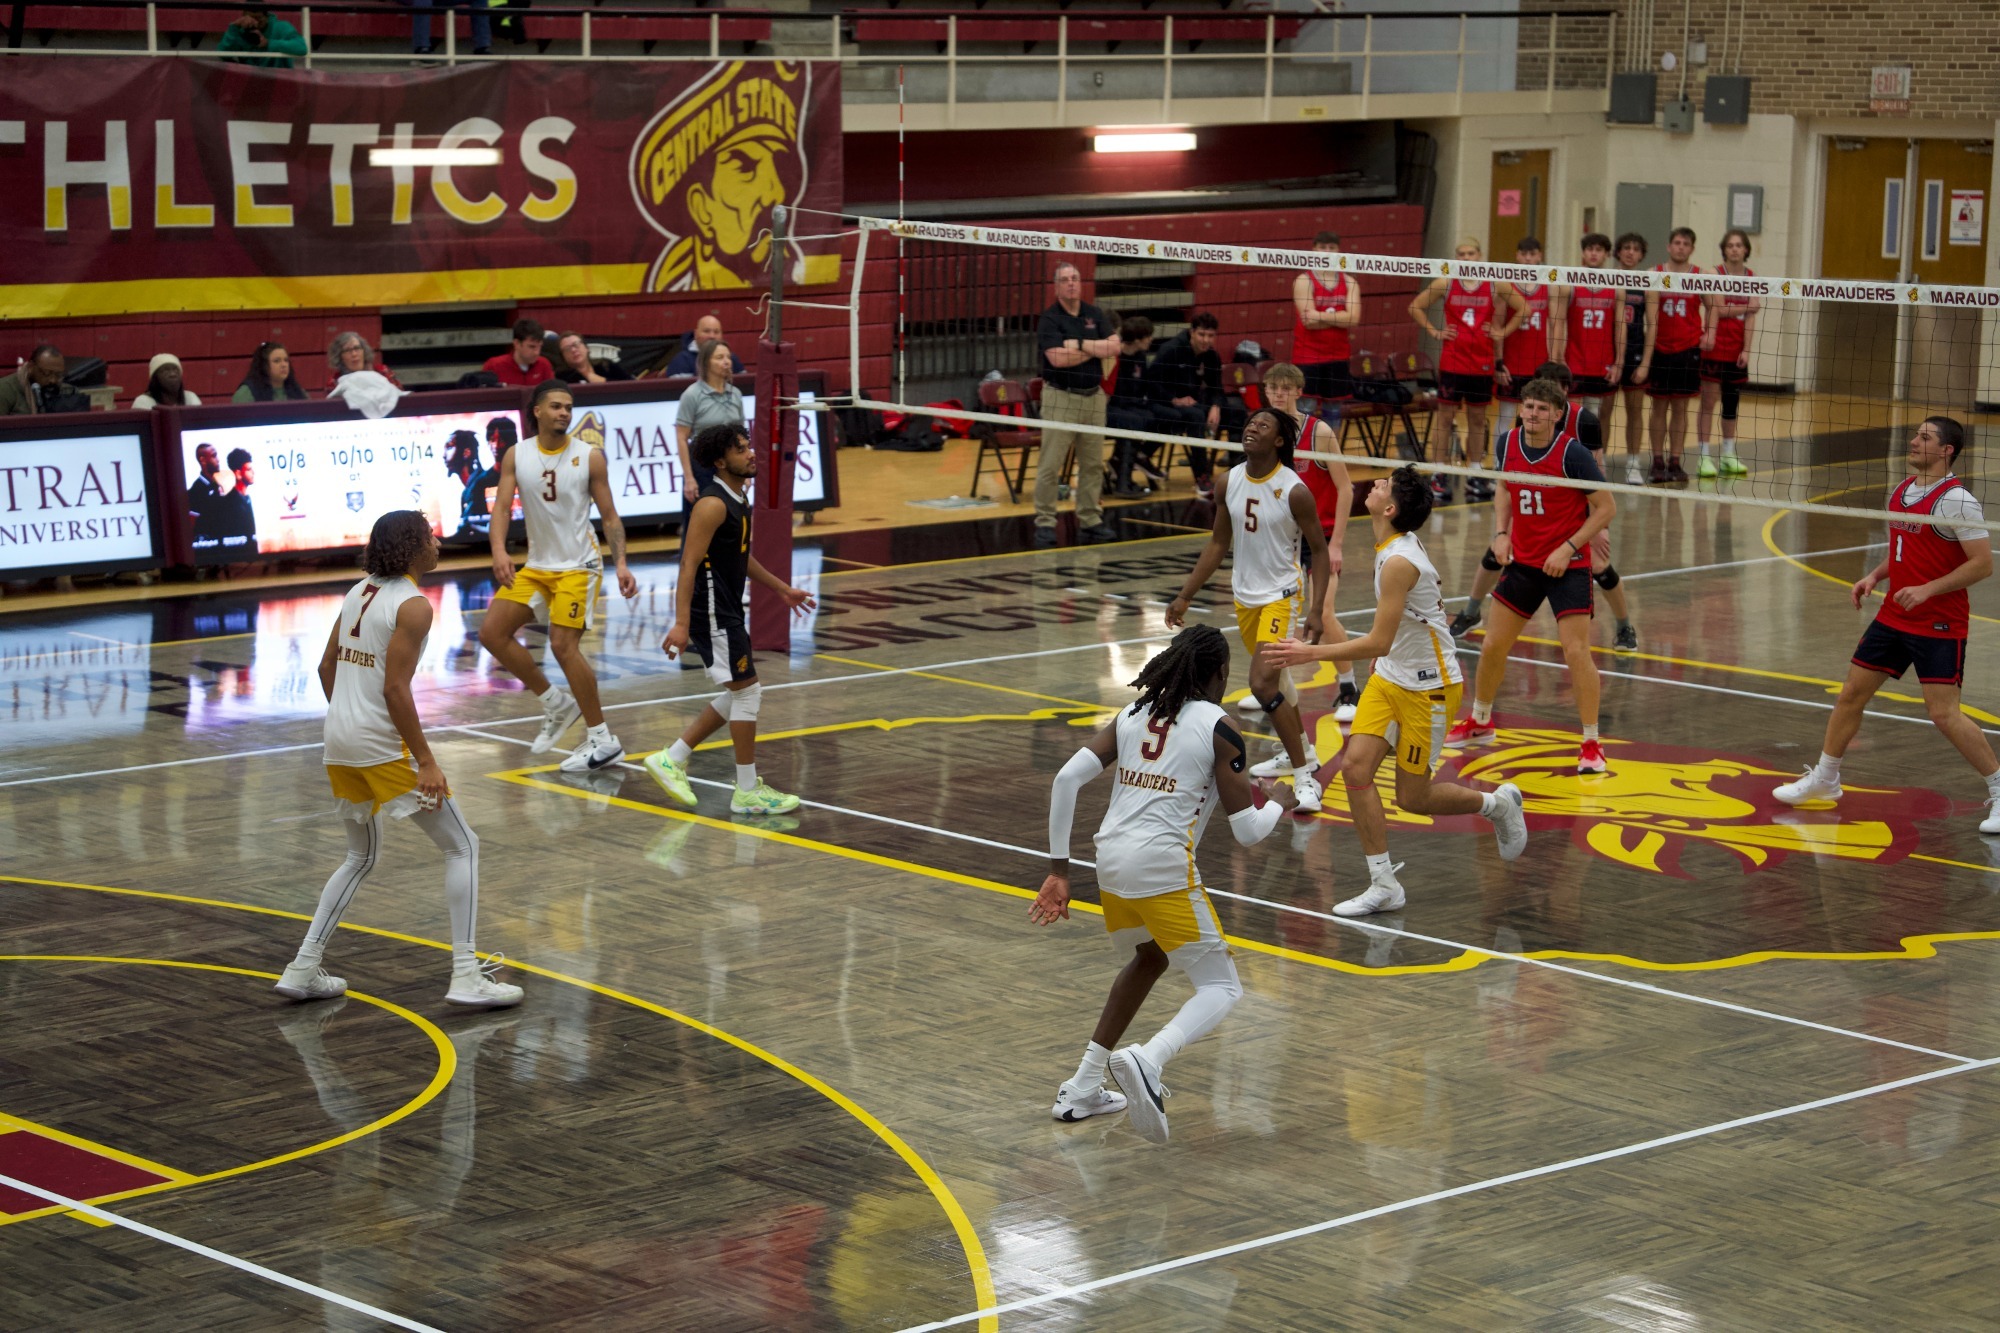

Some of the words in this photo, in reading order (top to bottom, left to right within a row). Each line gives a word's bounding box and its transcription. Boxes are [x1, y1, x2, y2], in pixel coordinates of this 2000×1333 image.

[1877, 73, 1898, 93] EXIT
[651, 91, 735, 206] CENTRAL
[736, 77, 796, 142] STATE
[902, 224, 965, 240] MARAUDERS
[986, 231, 1050, 248] MARAUDERS
[1074, 238, 1139, 255] MARAUDERS
[1163, 245, 1232, 262] MARAUDERS
[1257, 252, 1330, 269] MARAUDERS
[1356, 258, 1431, 275] MARAUDERS
[1458, 265, 1537, 282] MARAUDERS
[1566, 271, 1651, 288] MARAUDERS
[1681, 278, 1769, 295] MARAUDERS
[1801, 284, 1896, 302] MARAUDERS
[1461, 307, 1476, 327] 4
[1582, 308, 1605, 329] 27
[1662, 298, 1687, 318] 44
[269, 449, 306, 473] 10/8
[331, 445, 374, 469] 10/10
[391, 441, 434, 465] 10/14
[542, 469, 557, 502] 3
[1519, 489, 1545, 516] 21
[1245, 498, 1260, 534] 5
[1894, 534, 1904, 563] 1
[348, 582, 383, 639] 7
[568, 602, 580, 619] 3
[1270, 619, 1280, 635] 5
[1406, 745, 1422, 765] 11
